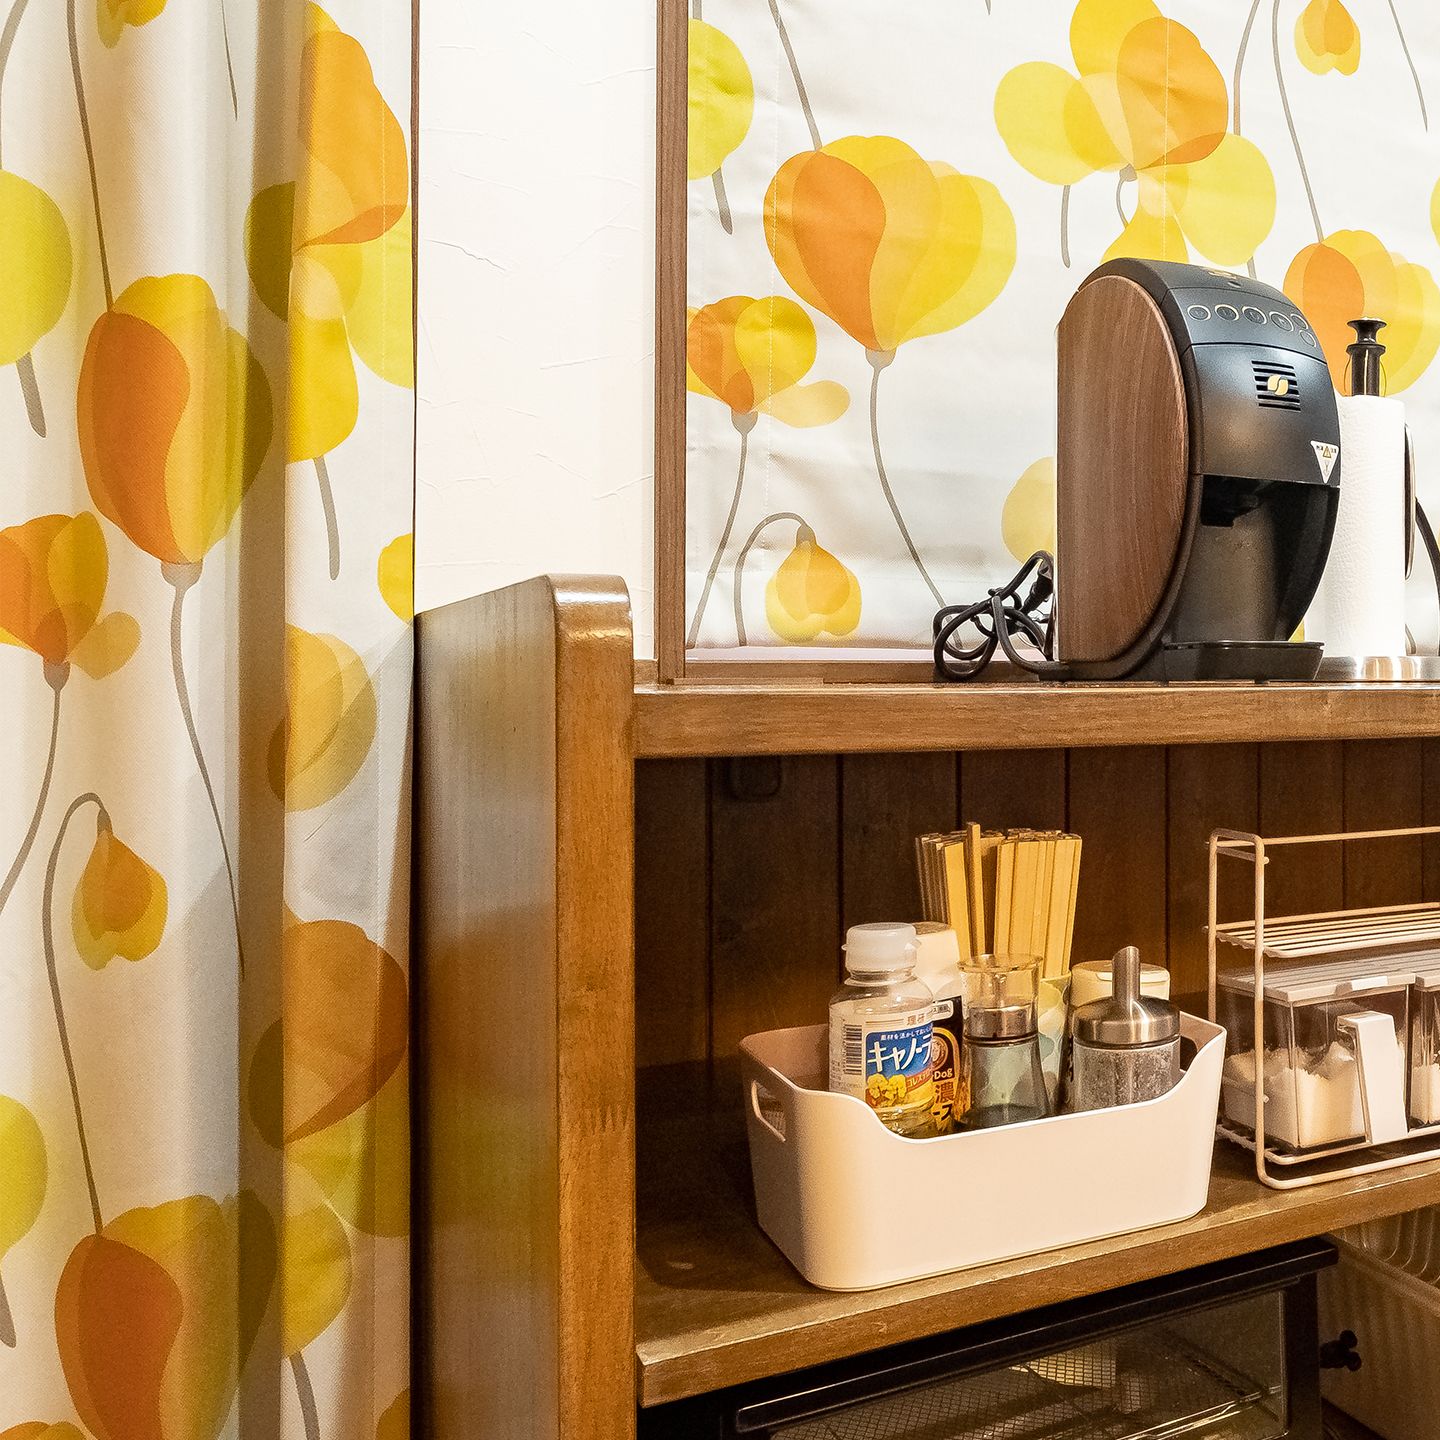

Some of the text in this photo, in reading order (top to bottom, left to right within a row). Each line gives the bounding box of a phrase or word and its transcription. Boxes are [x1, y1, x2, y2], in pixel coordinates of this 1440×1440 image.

[867, 1033, 932, 1073] キャノーラ
